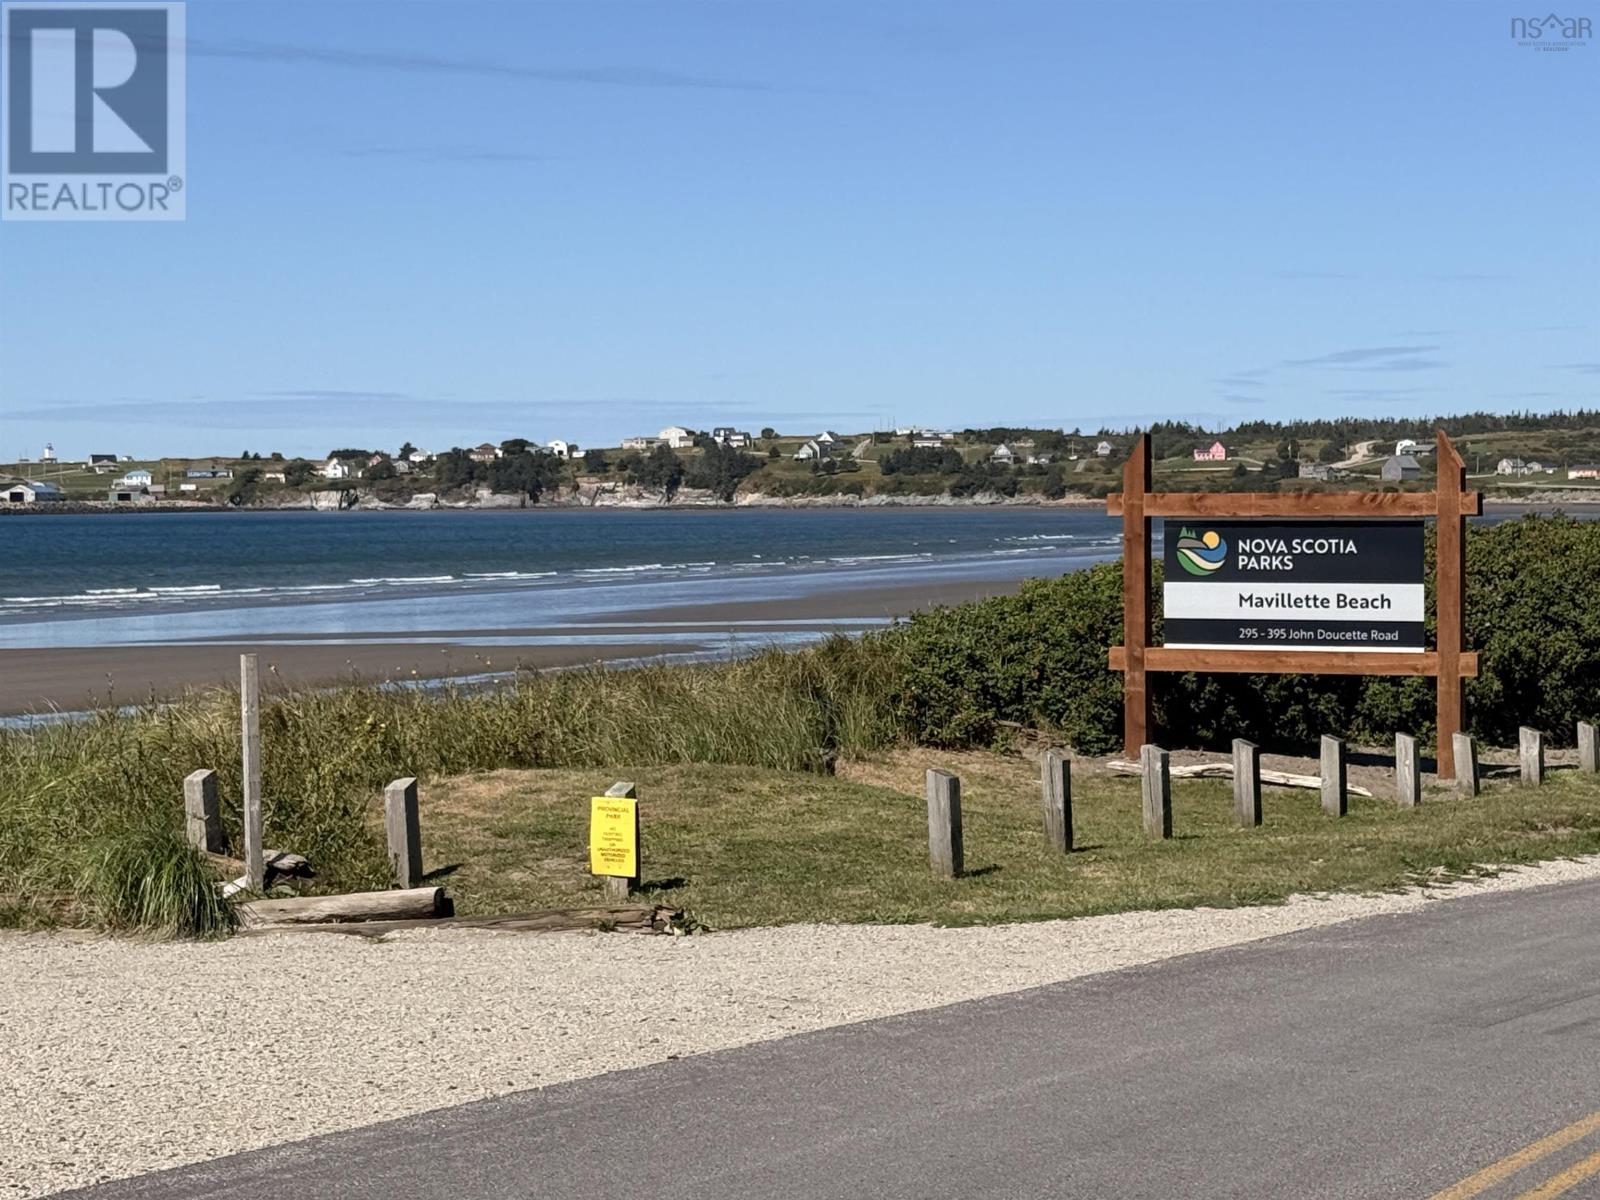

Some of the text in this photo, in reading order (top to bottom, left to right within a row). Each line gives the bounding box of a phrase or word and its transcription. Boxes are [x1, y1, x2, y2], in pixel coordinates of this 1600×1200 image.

[1238, 538, 1358, 554] NOVA SCOTIA
[1238, 555, 1294, 571] PARKS
[1238, 592, 1392, 610] Mavillette Beach
[1239, 627, 1259, 639] 295
[1267, 627, 1287, 640] 395
[1288, 628, 1315, 640] John
[1317, 628, 1368, 641] Doucette
[1370, 629, 1399, 641] Road
